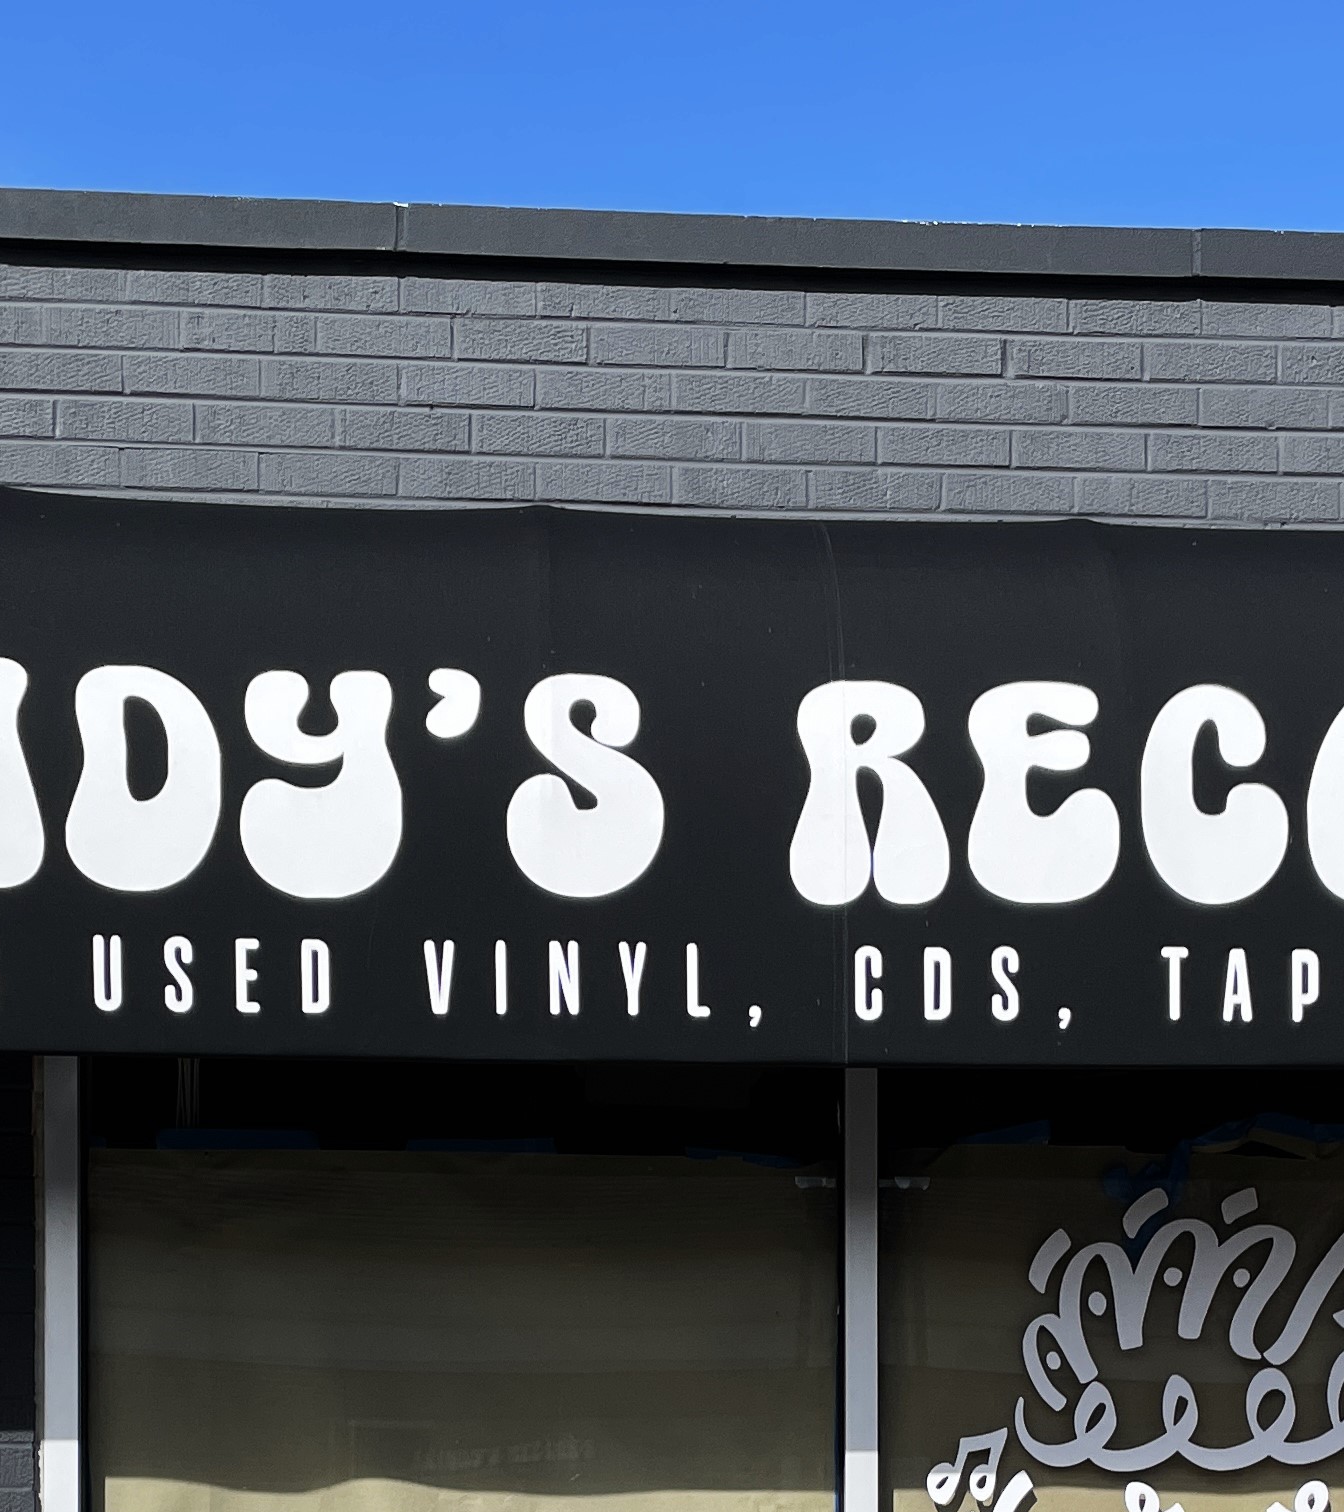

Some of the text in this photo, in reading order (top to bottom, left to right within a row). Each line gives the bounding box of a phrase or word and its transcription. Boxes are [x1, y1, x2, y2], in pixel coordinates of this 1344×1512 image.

[93, 935, 330, 1014] USED
[424, 940, 761, 1028] VINYL,
[855, 946, 1071, 1030] CDS,
